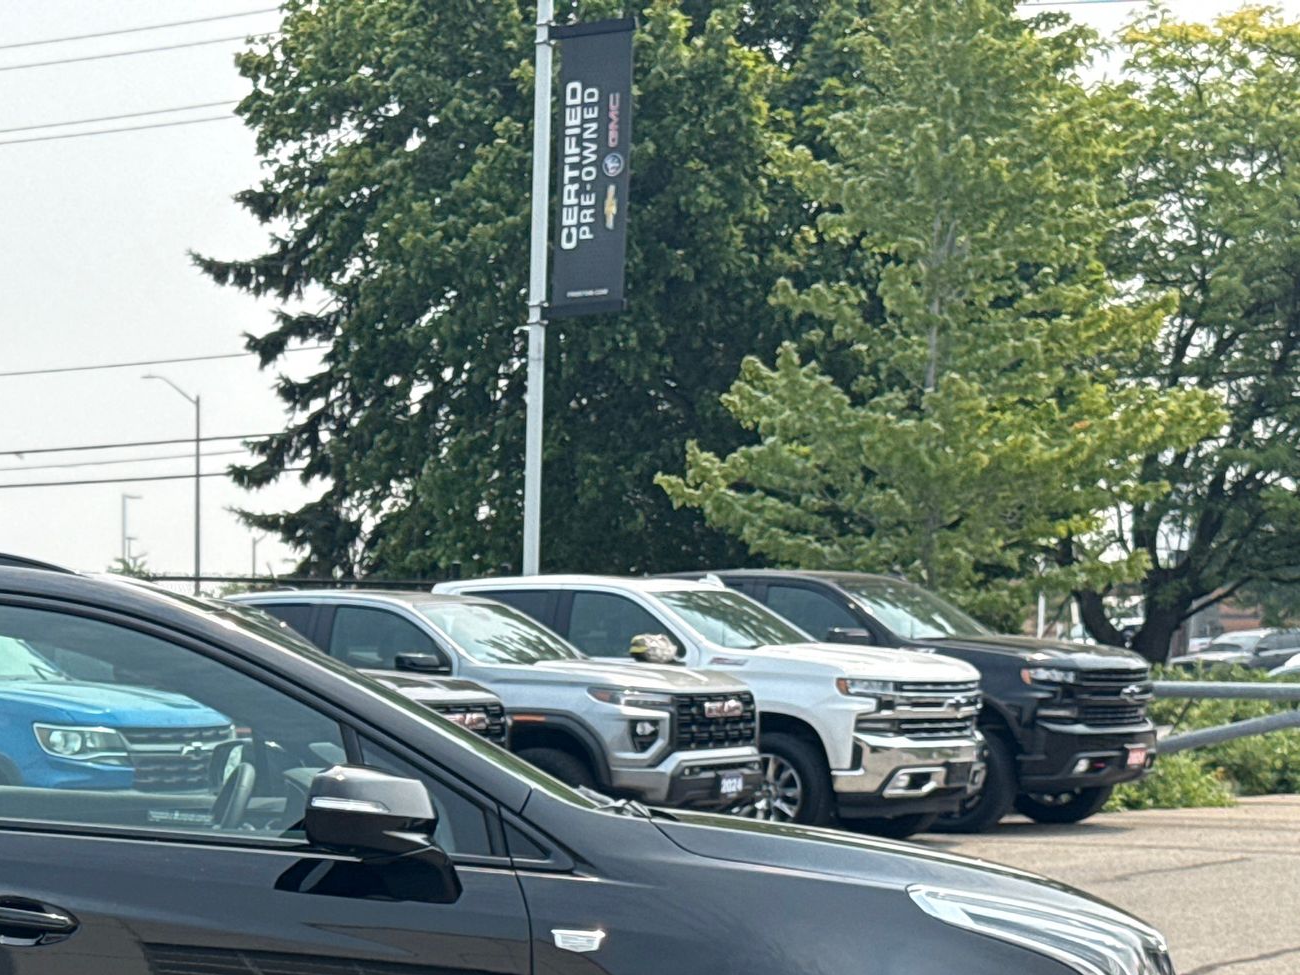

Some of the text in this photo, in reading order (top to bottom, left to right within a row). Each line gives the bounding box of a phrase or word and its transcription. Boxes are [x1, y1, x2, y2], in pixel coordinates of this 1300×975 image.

[561, 81, 582, 250] CERTIFIED
[579, 87, 599, 240] PRE-OWNED
[608, 92, 620, 148] GMC
